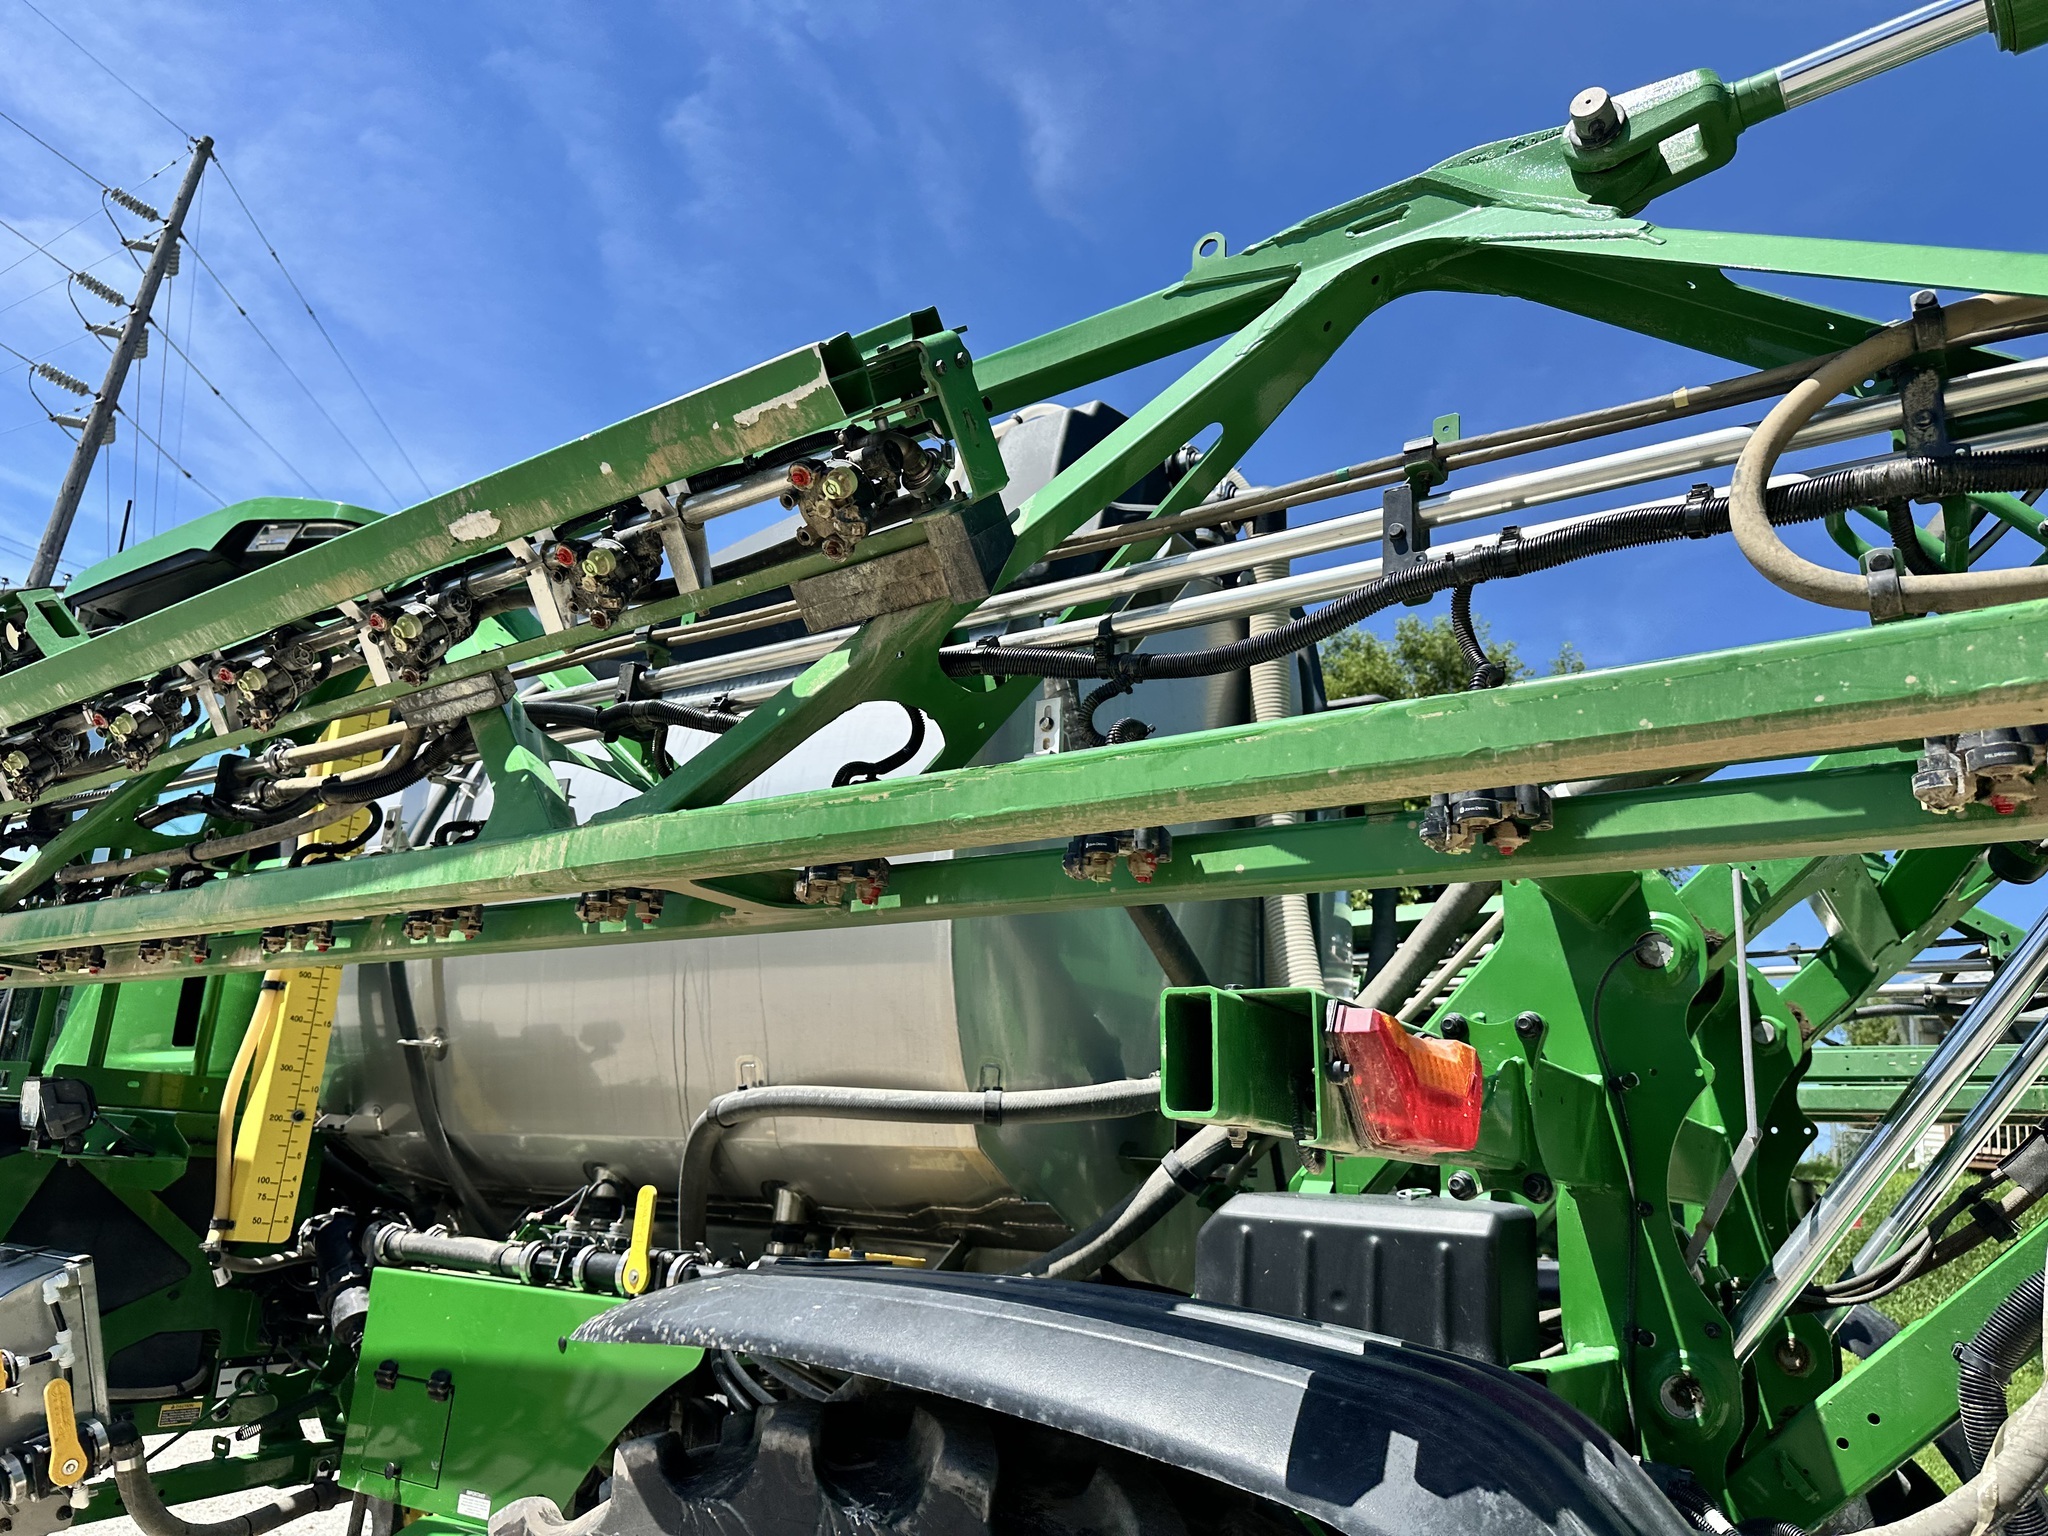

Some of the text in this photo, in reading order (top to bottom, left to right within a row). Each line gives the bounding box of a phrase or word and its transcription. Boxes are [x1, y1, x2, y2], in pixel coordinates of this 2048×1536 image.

[299, 970, 312, 979] 500
[290, 1015, 304, 1023] 400
[323, 1020, 332, 1028] 15
[280, 1063, 294, 1072] 300
[311, 1086, 320, 1094] 10
[269, 1113, 284, 1122] 200
[257, 1176, 271, 1185] 100
[292, 1175, 298, 1183] 4
[257, 1192, 267, 1201] 75
[288, 1191, 294, 1199] 3
[252, 1216, 262, 1225] 50
[283, 1216, 289, 1224] 2
